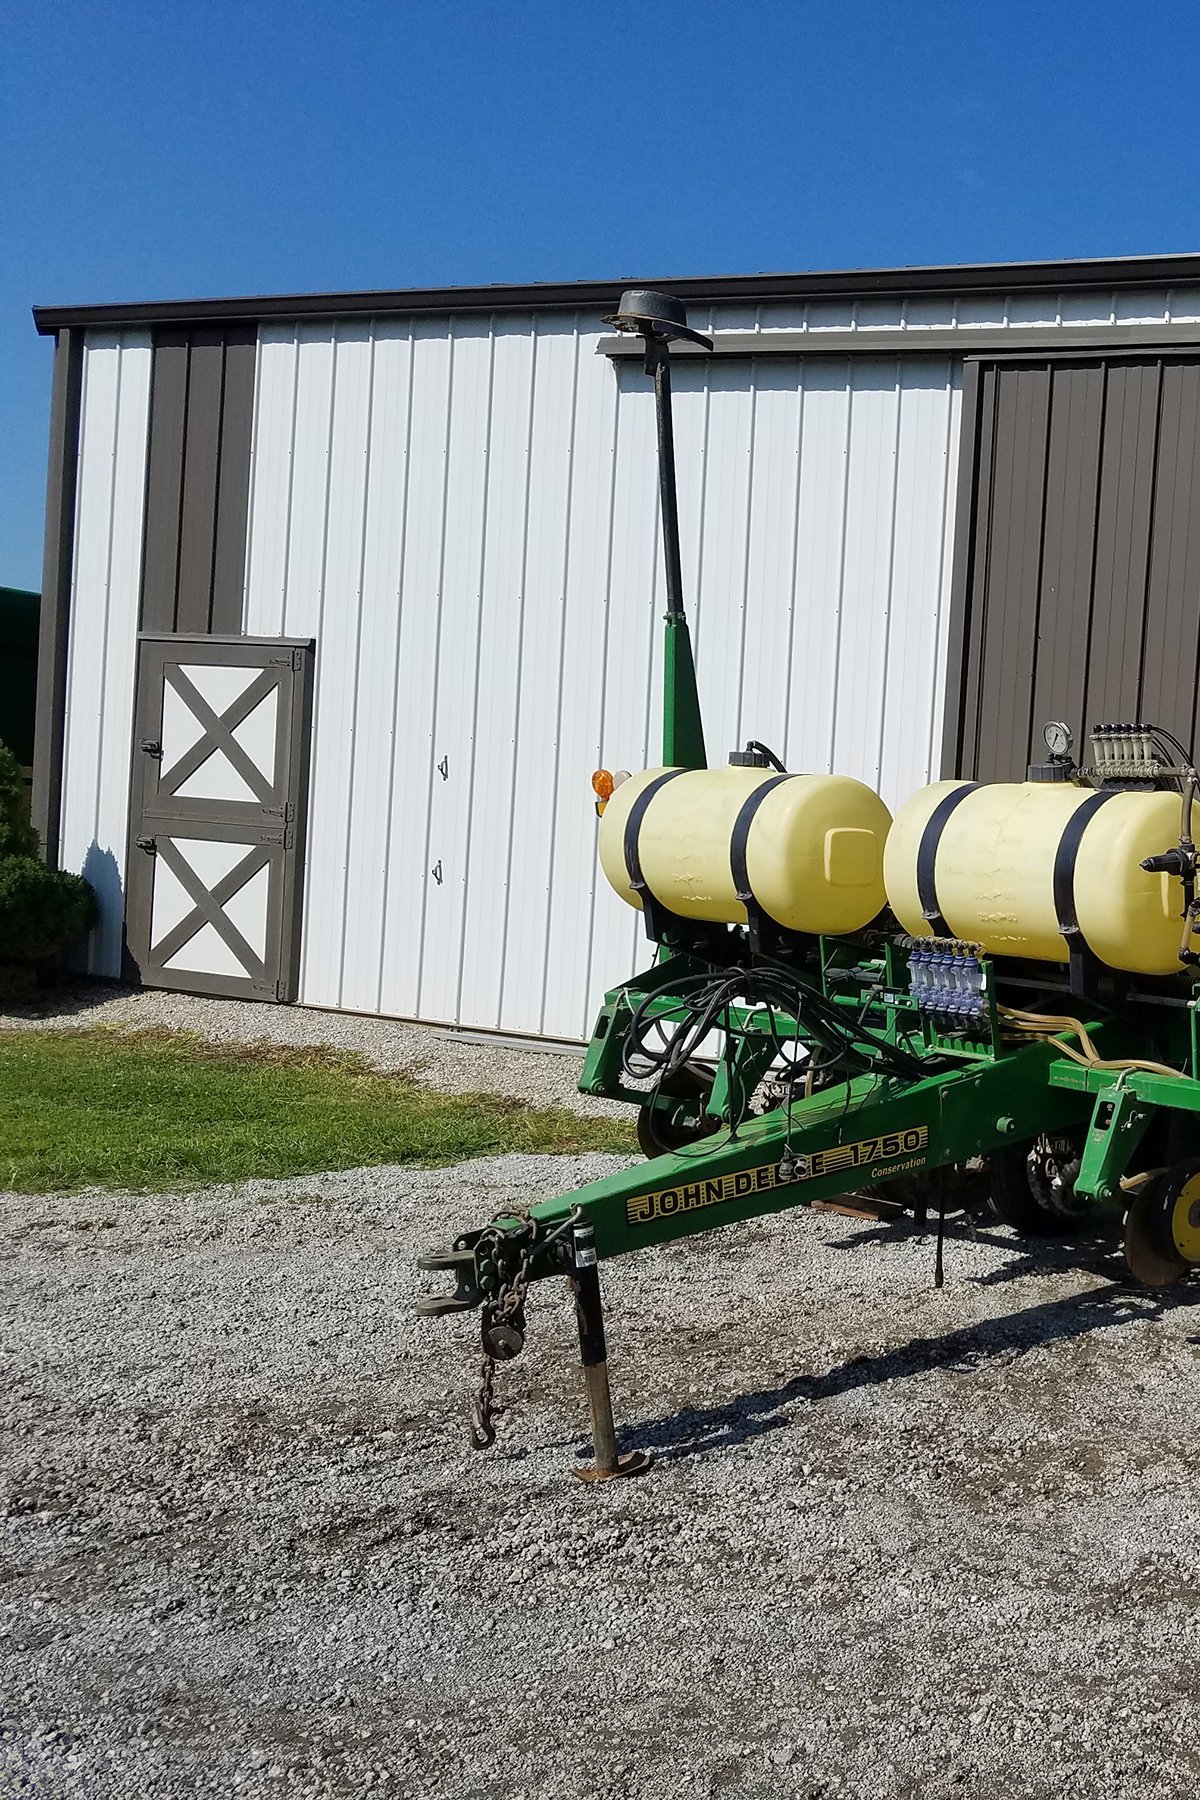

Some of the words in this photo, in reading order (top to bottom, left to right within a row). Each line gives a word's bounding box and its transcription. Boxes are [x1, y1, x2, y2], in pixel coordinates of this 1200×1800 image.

[637, 1178, 725, 1221] JOHN
[849, 1130, 922, 1166] 1750
[871, 1156, 926, 1179] Conservation
